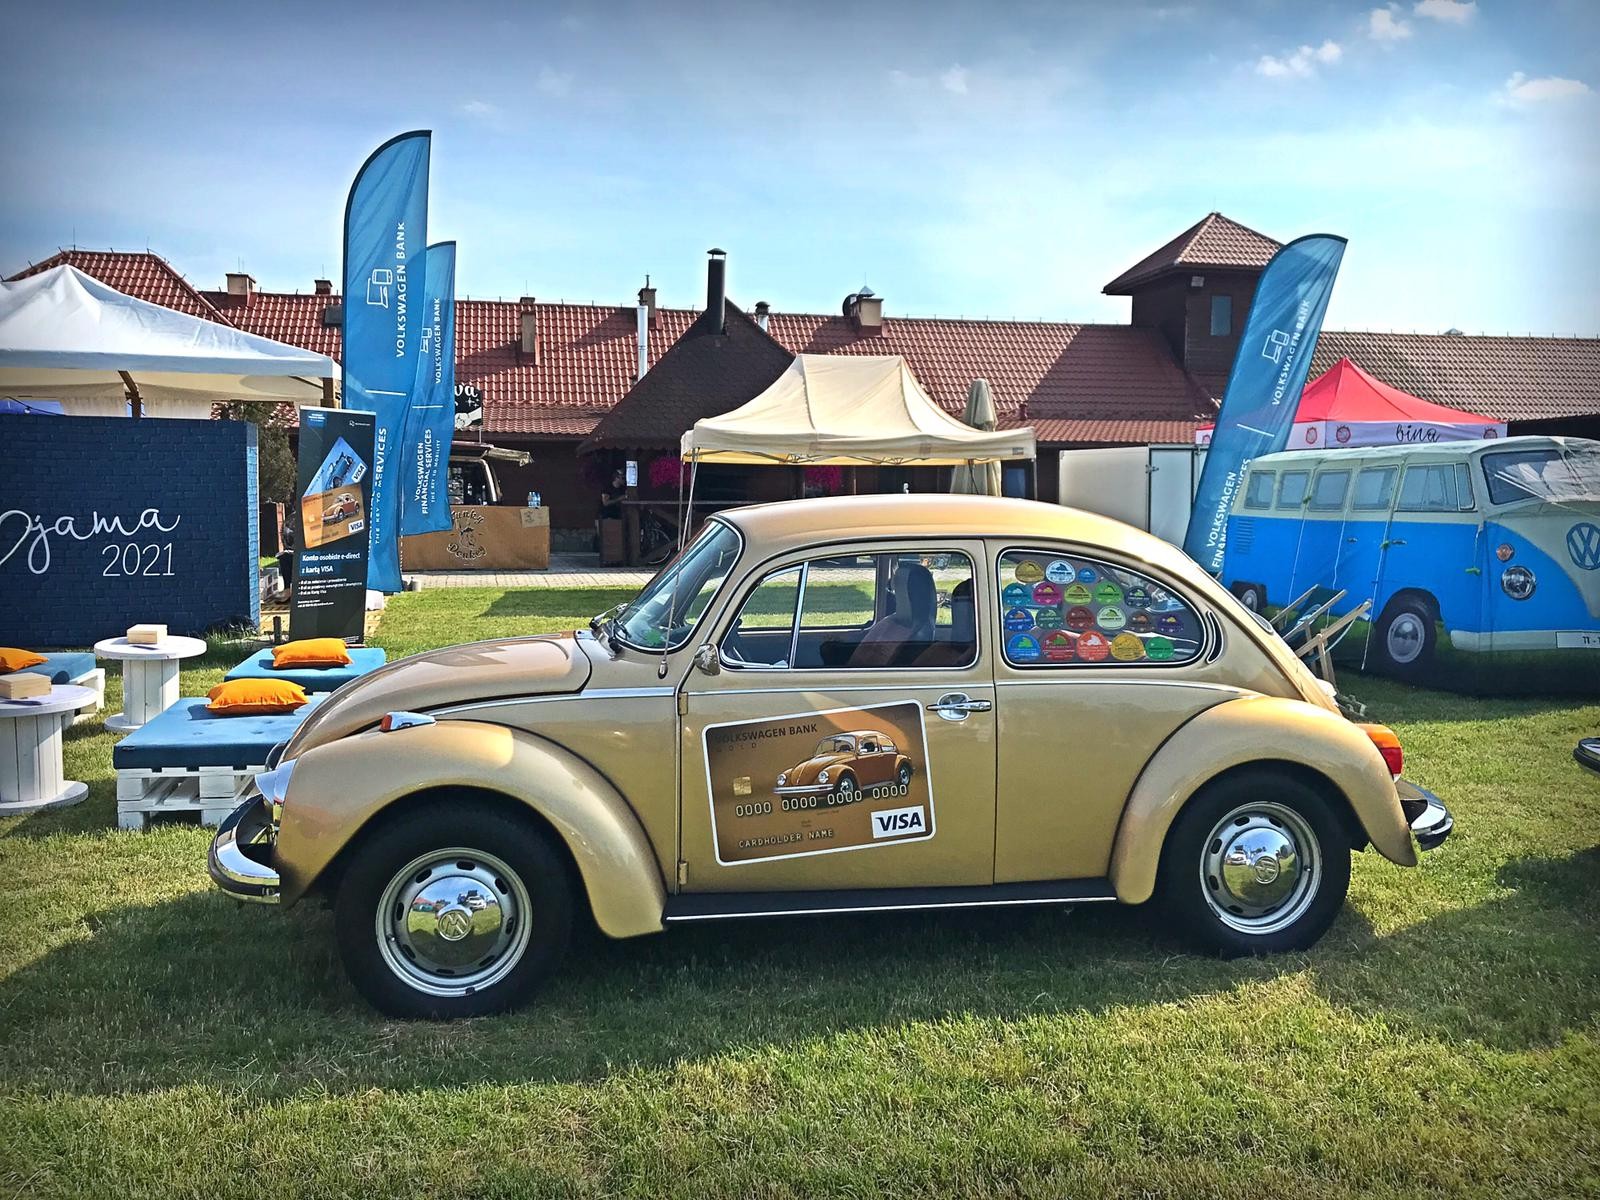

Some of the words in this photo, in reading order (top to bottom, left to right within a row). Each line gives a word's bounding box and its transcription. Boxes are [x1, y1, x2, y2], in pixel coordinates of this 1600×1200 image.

[396, 222, 406, 259] BANK
[396, 265, 407, 357] VOLKSWAGEN
[433, 297, 441, 321] BANK
[434, 325, 442, 384] VOLKSWAGEN
[1271, 332, 1301, 405] VOLKSWAGEN
[1295, 300, 1310, 330] BANK
[424, 428, 433, 468] SERVICES
[353, 465, 365, 480] VISA
[414, 442, 425, 502] VOLKSWAGEN
[421, 469, 431, 515] FINANCIAL
[350, 521, 363, 531] VISA
[1206, 471, 1237, 548] VOLKSWAGEN
[102, 542, 175, 577] 2021
[302, 554, 319, 562] Konto
[319, 553, 341, 561] osobiste
[341, 552, 361, 560] e-direct
[446, 543, 488, 560] Donkey
[789, 723, 818, 736] BANK
[735, 801, 772, 817] 0000
[781, 796, 817, 811] 0000
[827, 790, 863, 805] 0000
[872, 784, 908, 800] 0000
[738, 832, 802, 848] CARDHOLDER
[808, 829, 834, 840] NAME
[875, 812, 922, 832] VISA
